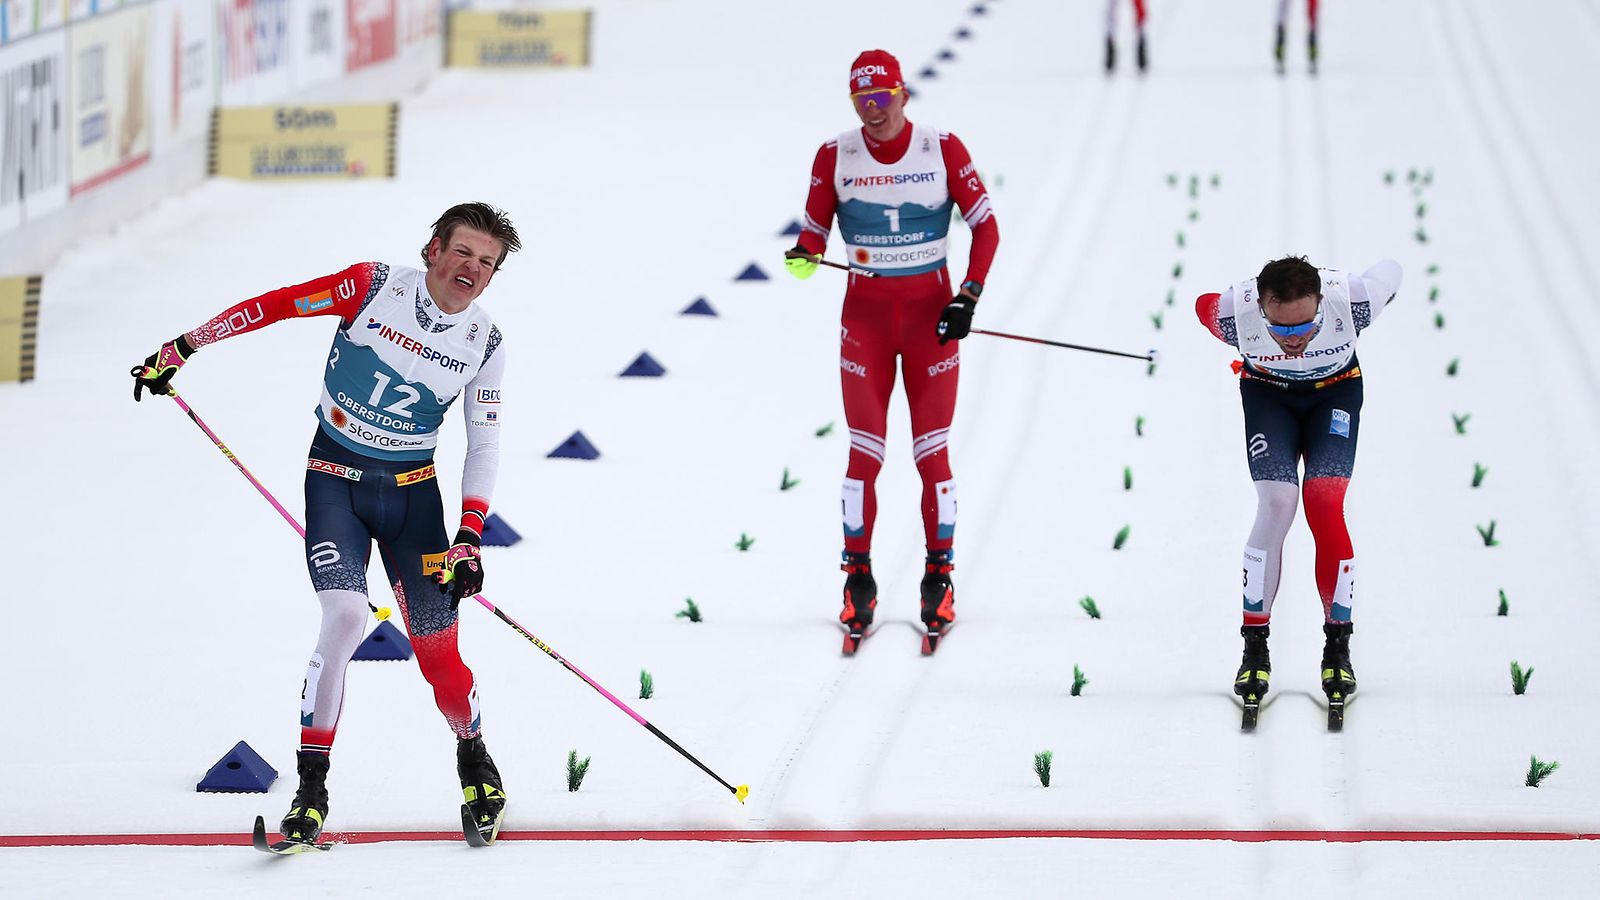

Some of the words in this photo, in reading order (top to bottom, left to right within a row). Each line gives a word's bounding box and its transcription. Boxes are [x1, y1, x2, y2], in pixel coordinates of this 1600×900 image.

[854, 172, 936, 187] INTERSPORT
[884, 208, 901, 233] 1
[854, 231, 926, 245] OBERSTDORF
[378, 324, 470, 374] INTERSPORT
[1259, 342, 1353, 362] INTERSPORT
[367, 370, 422, 419] 12
[336, 390, 417, 432] OBERSTDORF
[306, 460, 346, 475] SPAR
